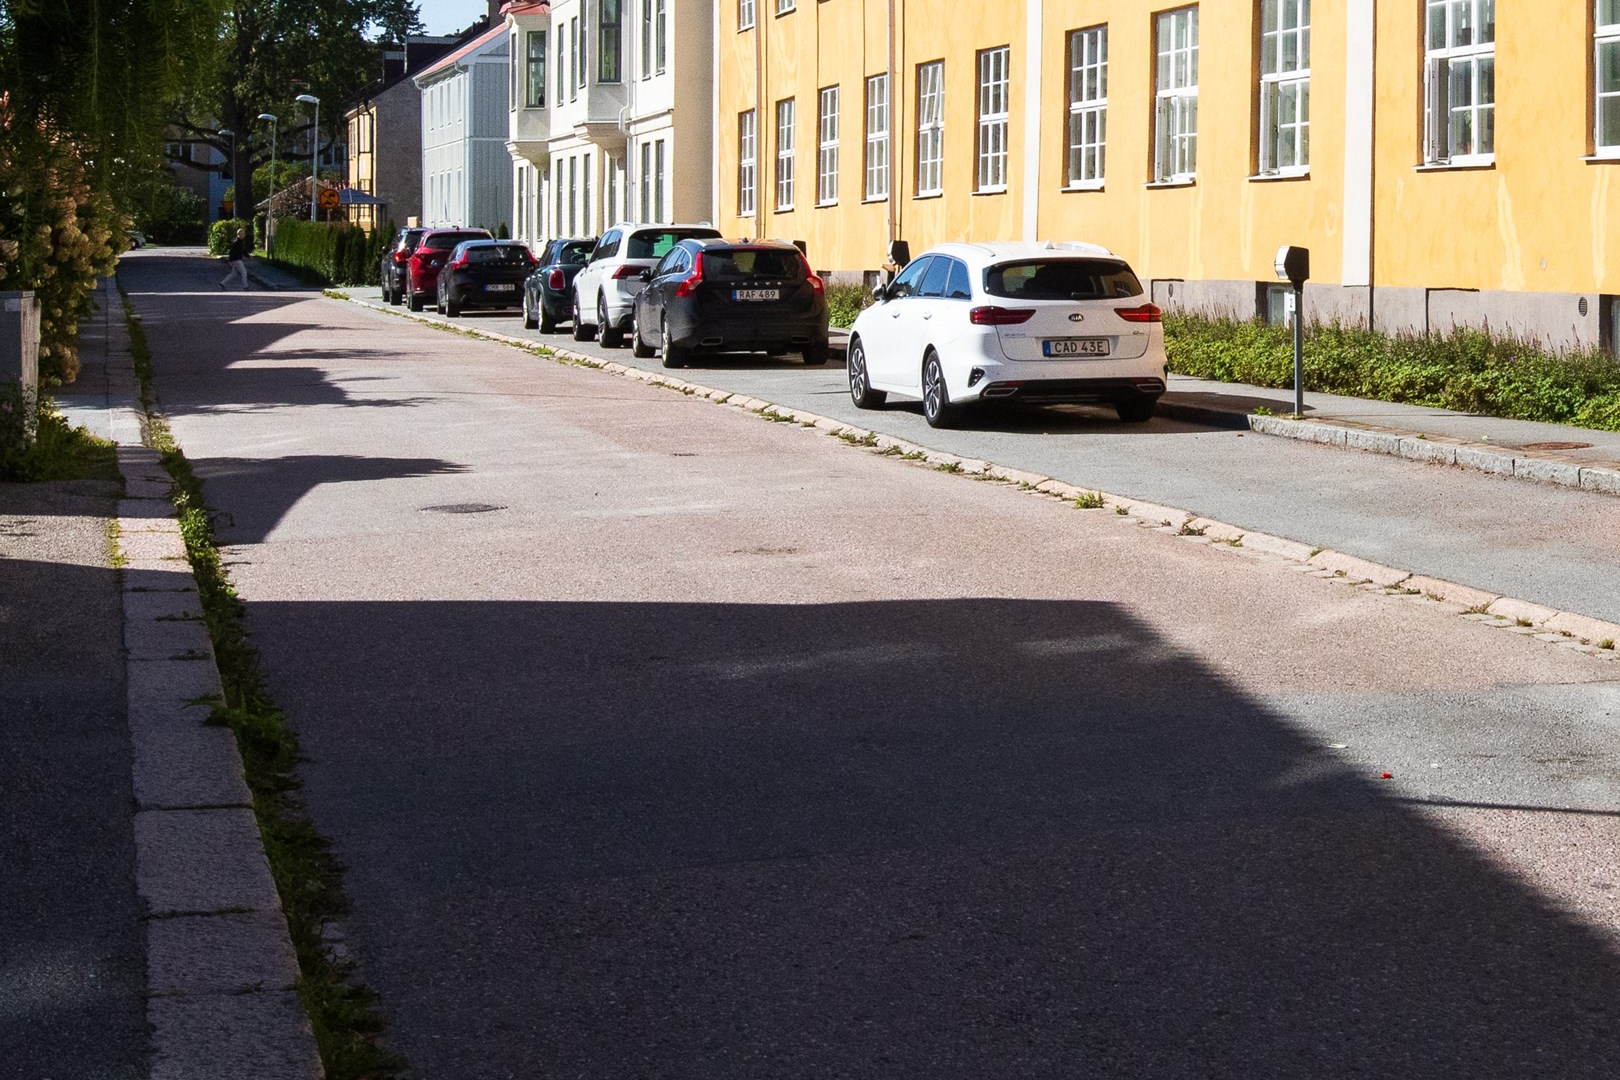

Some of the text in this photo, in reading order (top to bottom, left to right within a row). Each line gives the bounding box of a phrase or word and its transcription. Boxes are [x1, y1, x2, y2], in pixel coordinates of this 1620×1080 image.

[739, 290, 776, 299] RAF 489
[1054, 341, 1104, 353] CAD 43E
